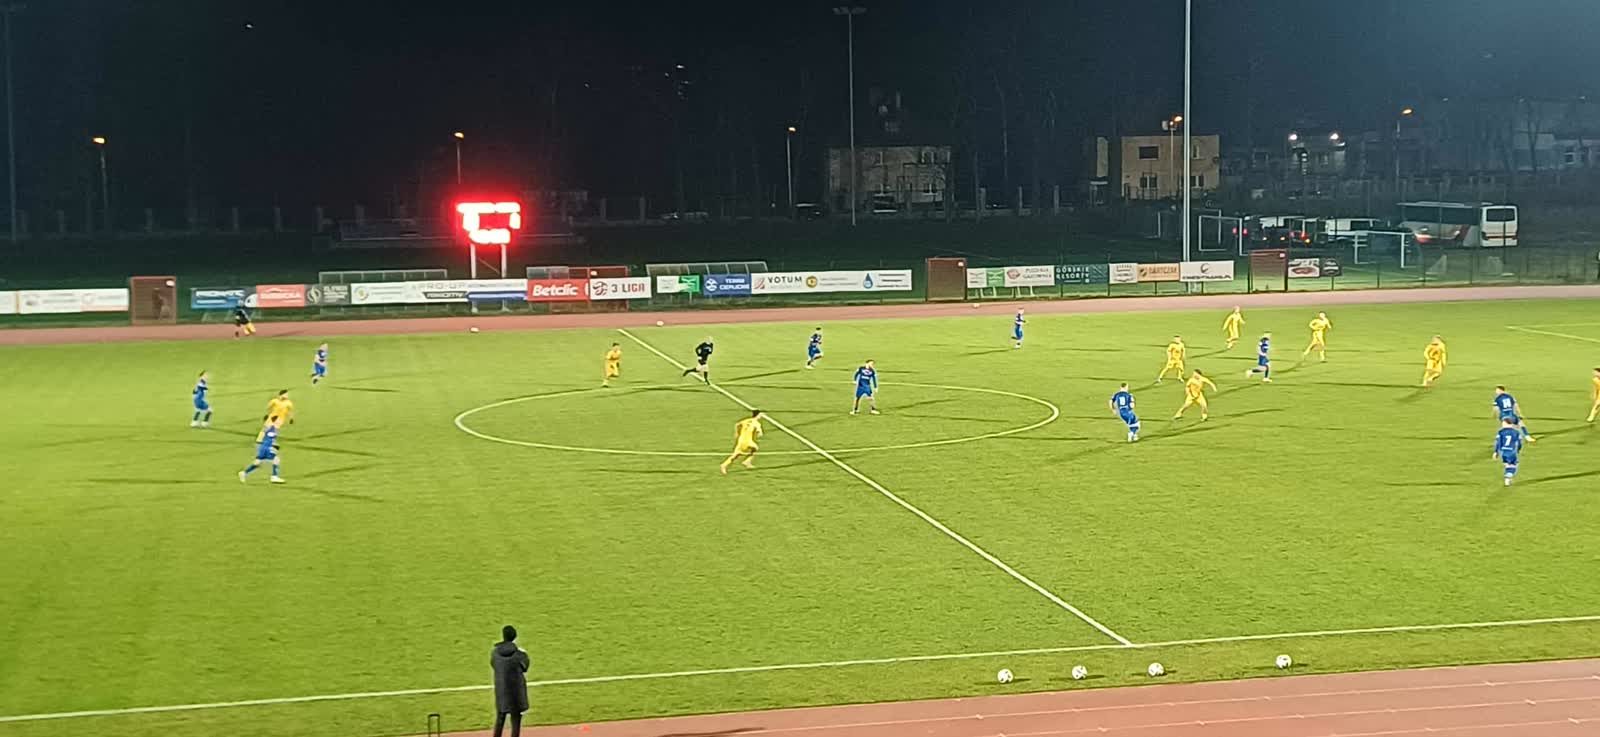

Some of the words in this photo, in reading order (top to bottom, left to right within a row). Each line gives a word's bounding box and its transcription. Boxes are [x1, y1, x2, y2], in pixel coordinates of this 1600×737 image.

[768, 275, 802, 284] VOTUM
[532, 284, 579, 297] Betclic
[611, 283, 618, 293] 3
[622, 282, 645, 293] LIGA
[1505, 435, 1512, 446] 7
